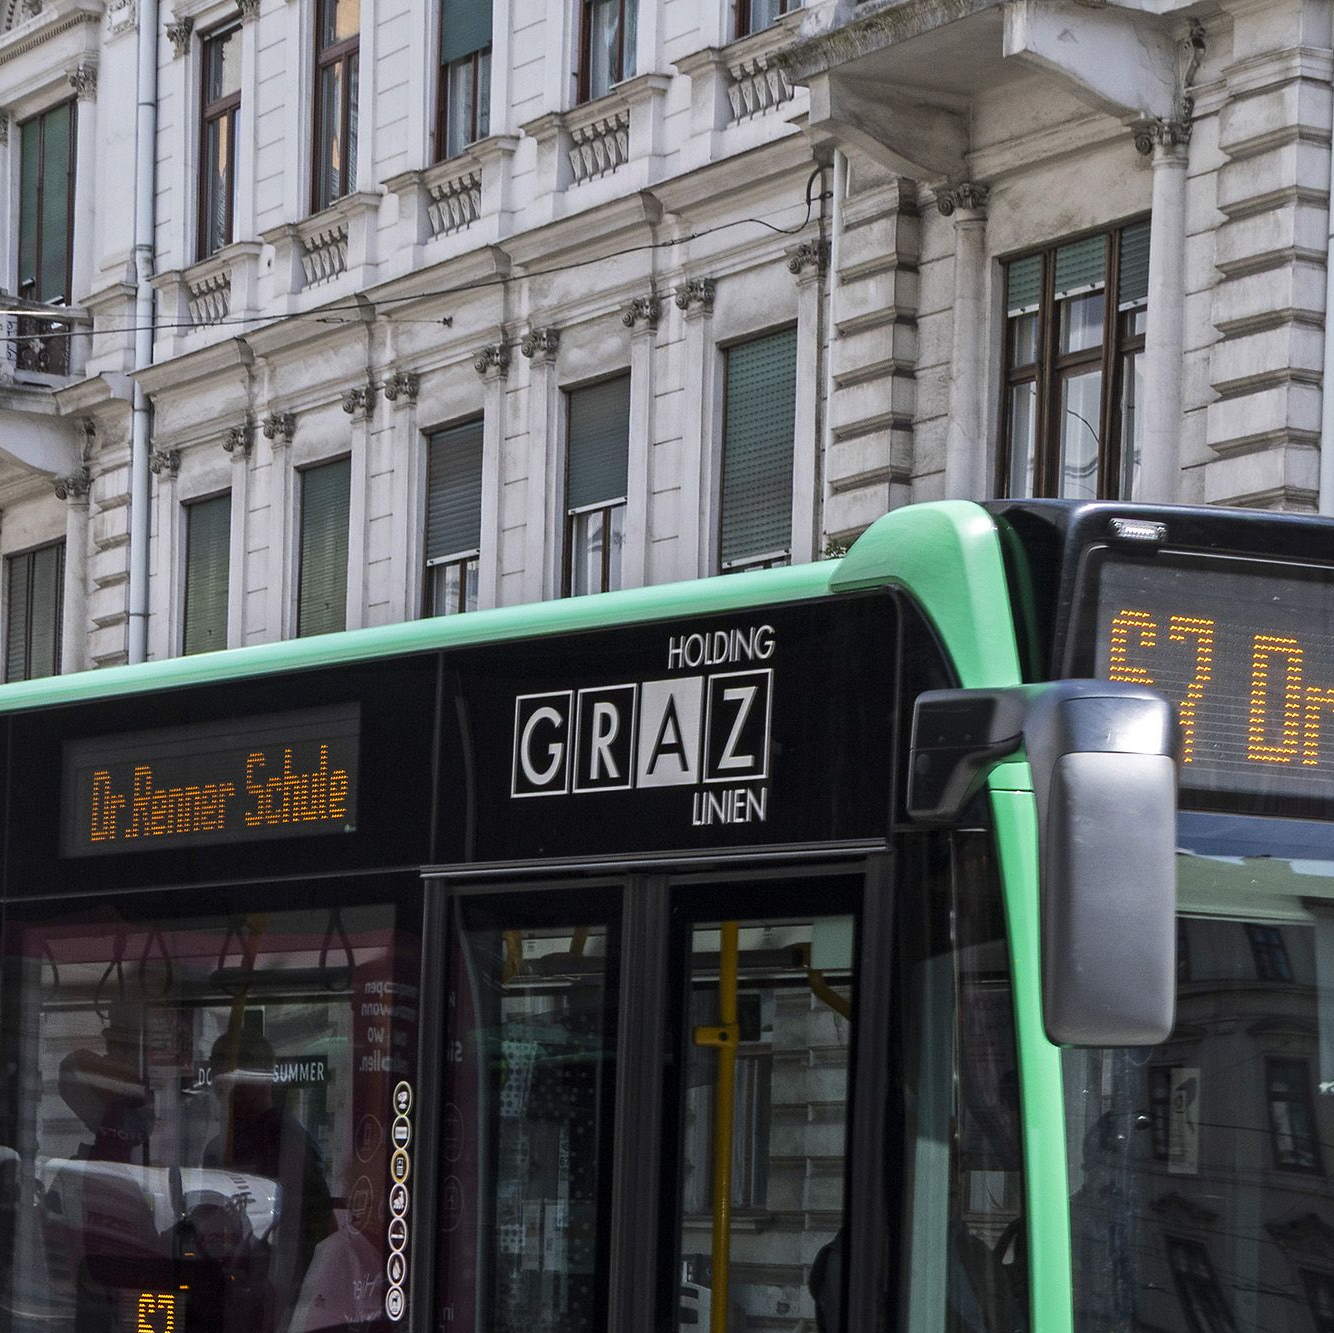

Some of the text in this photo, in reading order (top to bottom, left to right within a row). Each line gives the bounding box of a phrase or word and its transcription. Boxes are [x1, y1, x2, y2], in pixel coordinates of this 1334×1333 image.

[668, 624, 776, 669] HOLDING
[520, 684, 760, 786] GRAZ
[90, 744, 349, 842] Dr.Renner Schule
[691, 786, 767, 826] LINIEN
[272, 1061, 325, 1083] SUMMER
